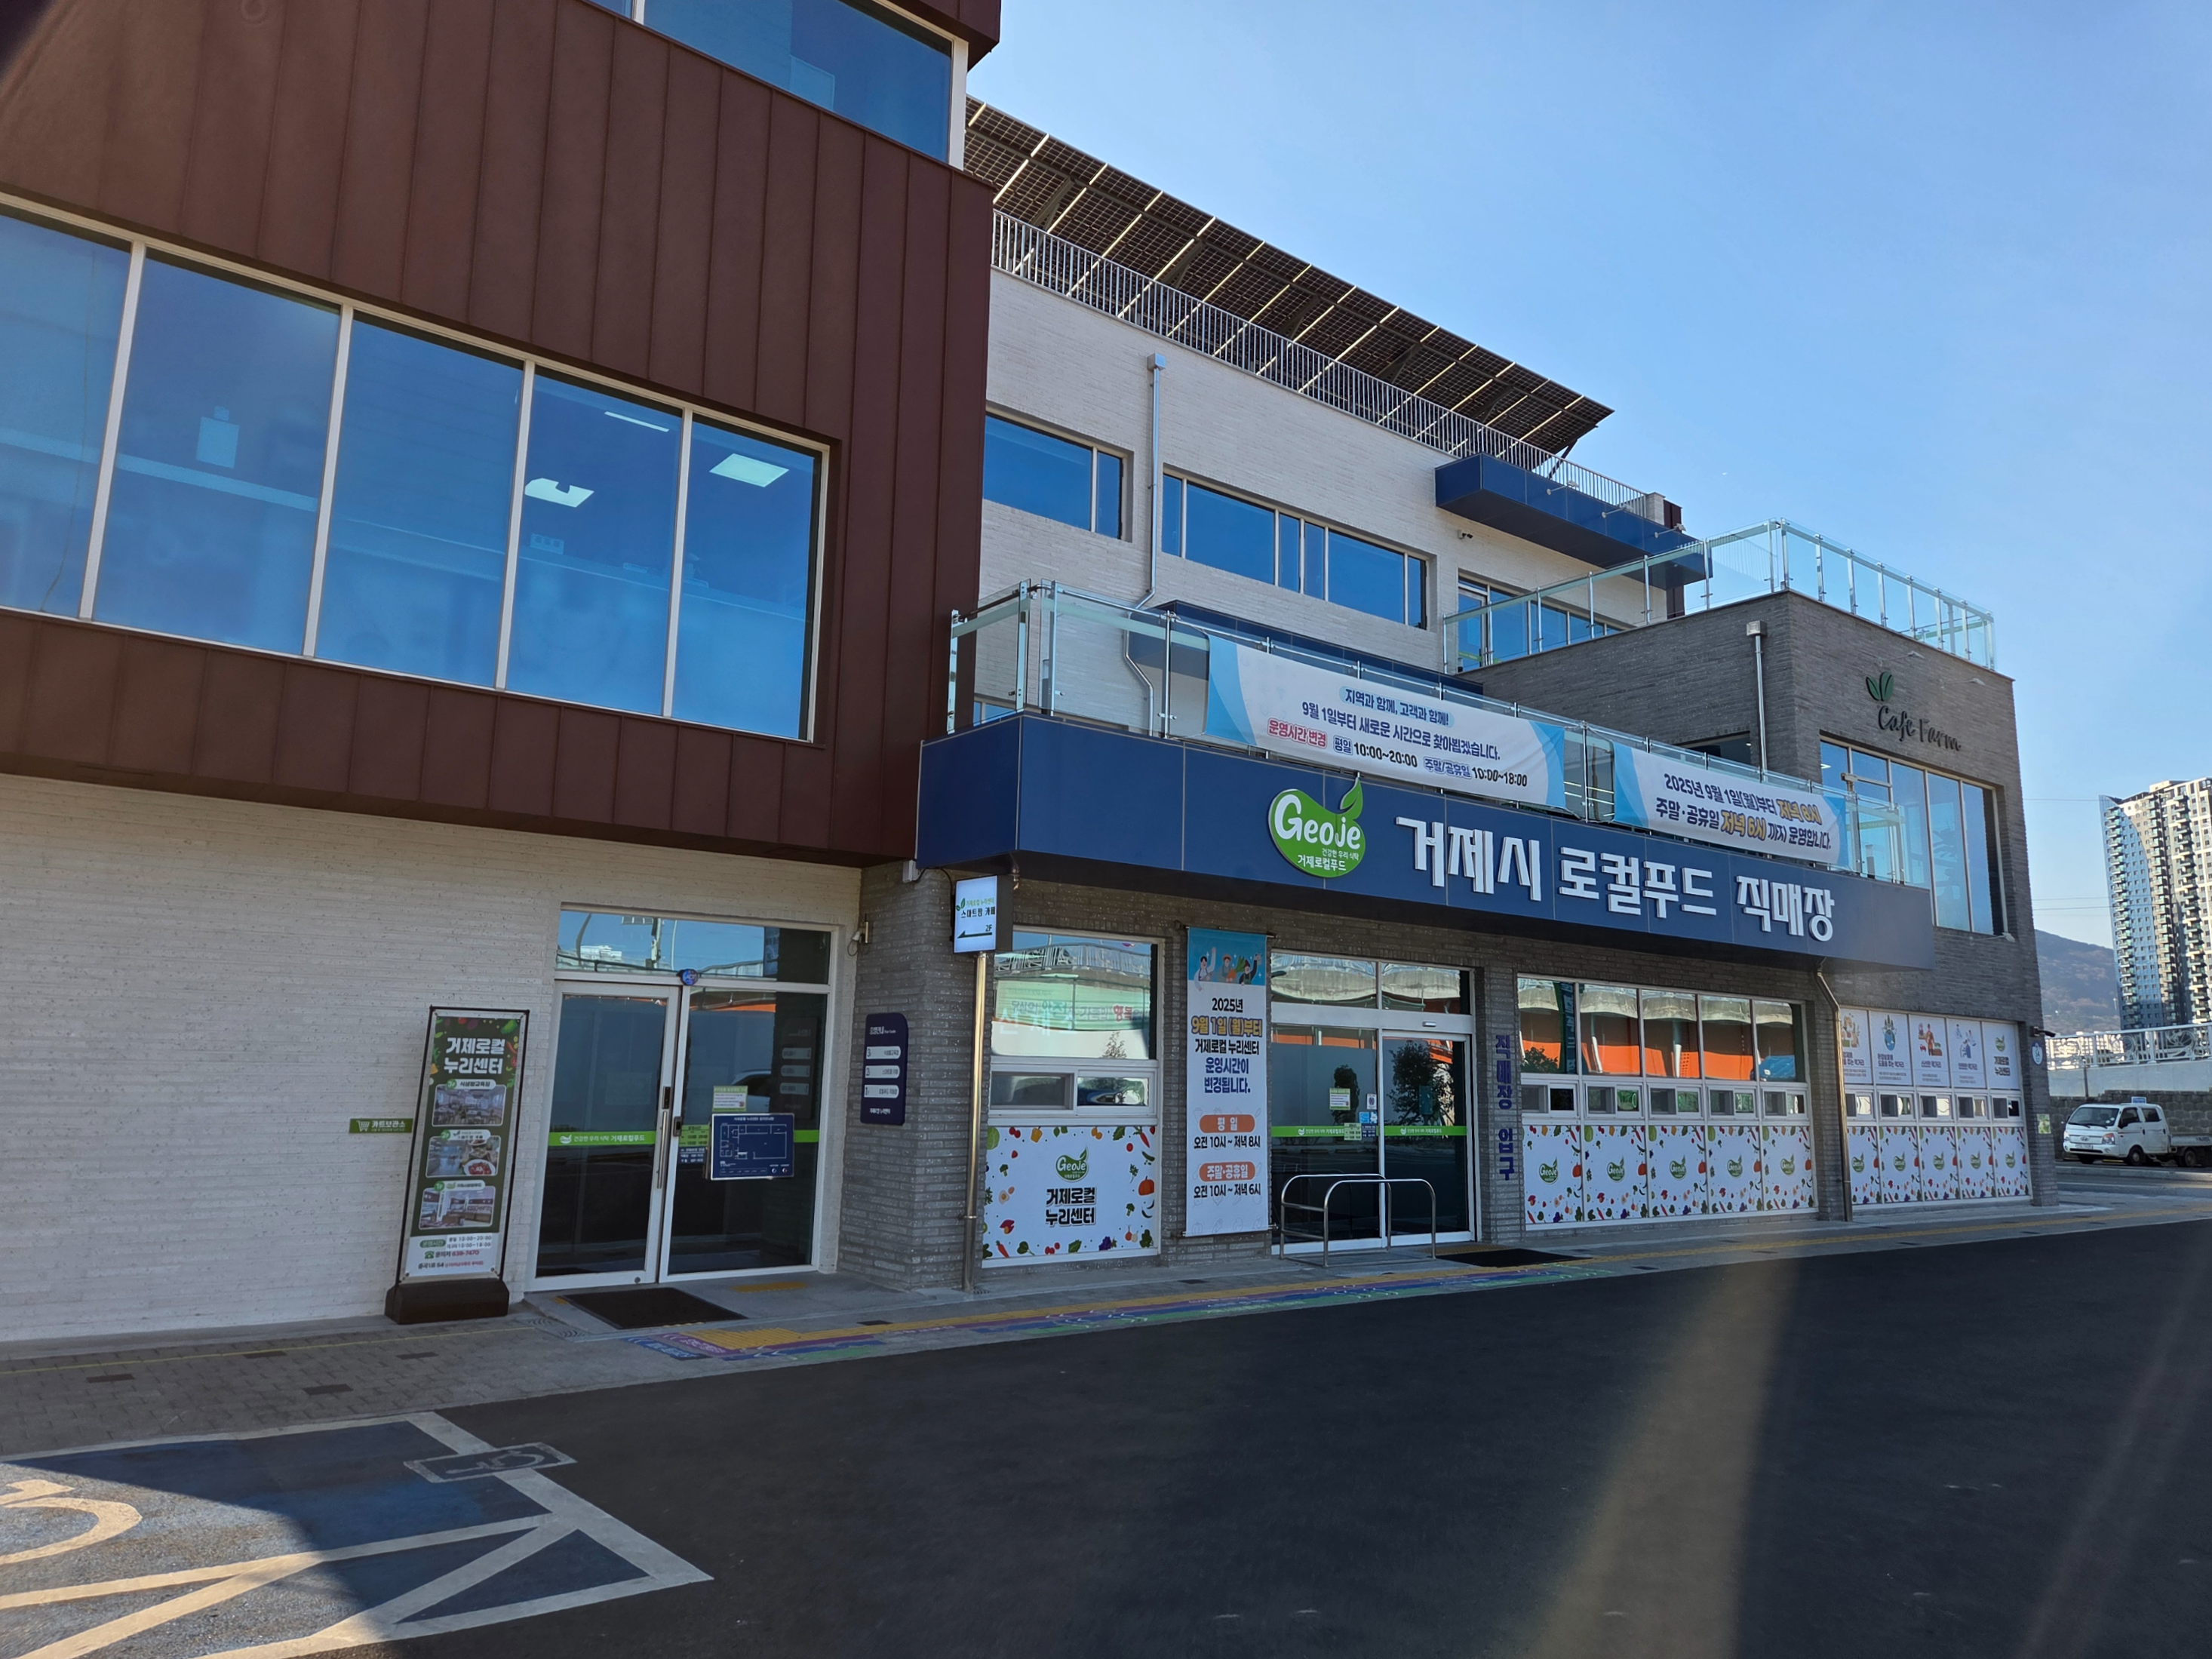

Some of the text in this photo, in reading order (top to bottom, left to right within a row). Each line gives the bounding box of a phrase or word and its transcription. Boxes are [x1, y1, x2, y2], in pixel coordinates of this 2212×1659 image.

[1344, 688, 1449, 726] 지역과 함께, 고객과 함께!
[1302, 702, 1501, 761] 9월 1일부터 새로운 시간으로 찾아뵙겠습니다.
[1878, 705, 1916, 742] Cafe
[1268, 720, 1528, 788] 운영시간 변경 평일 10:00~20:00 주말/공휴일 10:00~18:00
[1664, 773, 1823, 826] 2025년 9월 1일(월)부터 저녁 8시
[1274, 794, 1362, 849] Geoje
[1721, 810, 1746, 836] 저녁
[1747, 816, 1767, 841] 6시
[1768, 822, 1787, 842] 까지
[1789, 827, 1832, 850] 운영합니다.
[1297, 854, 1347, 871] 거제로컬푸드
[1322, 848, 1338, 858] 건강한
[1338, 850, 1349, 860] 우리
[1396, 816, 1835, 942] 거제시 로컬푸드 직매장
[960, 908, 983, 918] 스마트팜
[1212, 997, 1243, 1013] 2025년
[1191, 1015, 1209, 1035] 9월
[446, 1037, 505, 1055] 거제로컬
[1195, 1039, 1259, 1055] 거제로컬 누리센터
[444, 1058, 503, 1074] 누리센터
[1206, 1057, 1249, 1074] 운영시간이
[1495, 1034, 1513, 1110] 직매장
[1204, 1077, 1251, 1093] 변경됩니다.
[1194, 1136, 1208, 1149] 오전
[1210, 1135, 1226, 1148] 10시
[1234, 1135, 1247, 1147] 저녁
[1249, 1135, 1261, 1147] 8시
[1498, 1128, 1515, 1181] 입구
[1057, 1157, 1086, 1172] Geoje
[1540, 1164, 1557, 1176] Geoje
[1046, 1187, 1095, 1205] 거제로컬
[1194, 1185, 1208, 1198] 오전
[1210, 1184, 1226, 1197] 10시
[1234, 1183, 1248, 1196] 저녁
[1249, 1183, 1261, 1196] 6시
[1046, 1207, 1095, 1225] 누리센터
